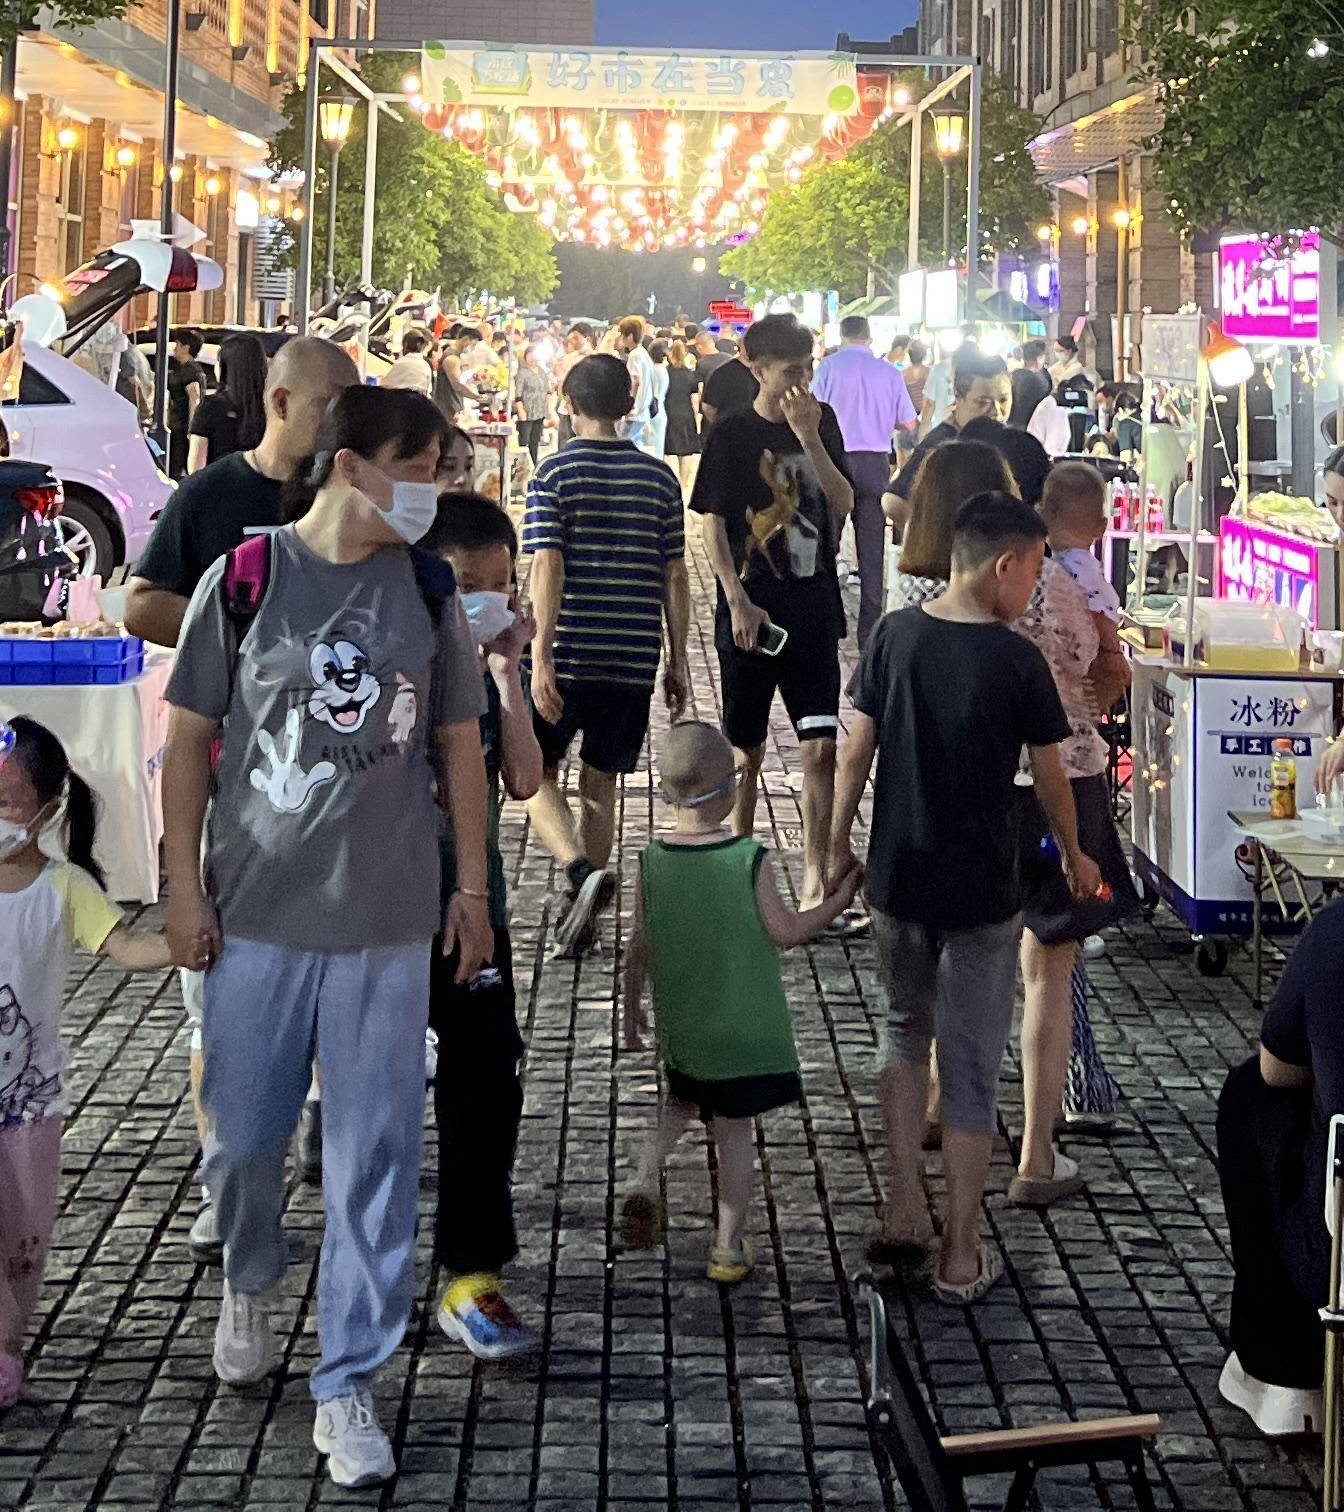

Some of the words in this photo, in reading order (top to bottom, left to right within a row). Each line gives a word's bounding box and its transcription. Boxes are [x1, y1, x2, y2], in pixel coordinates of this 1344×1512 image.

[1230, 695, 1302, 727] 冰粉
[1225, 738, 1307, 754] 手工作
[1232, 765, 1271, 779] Welc
